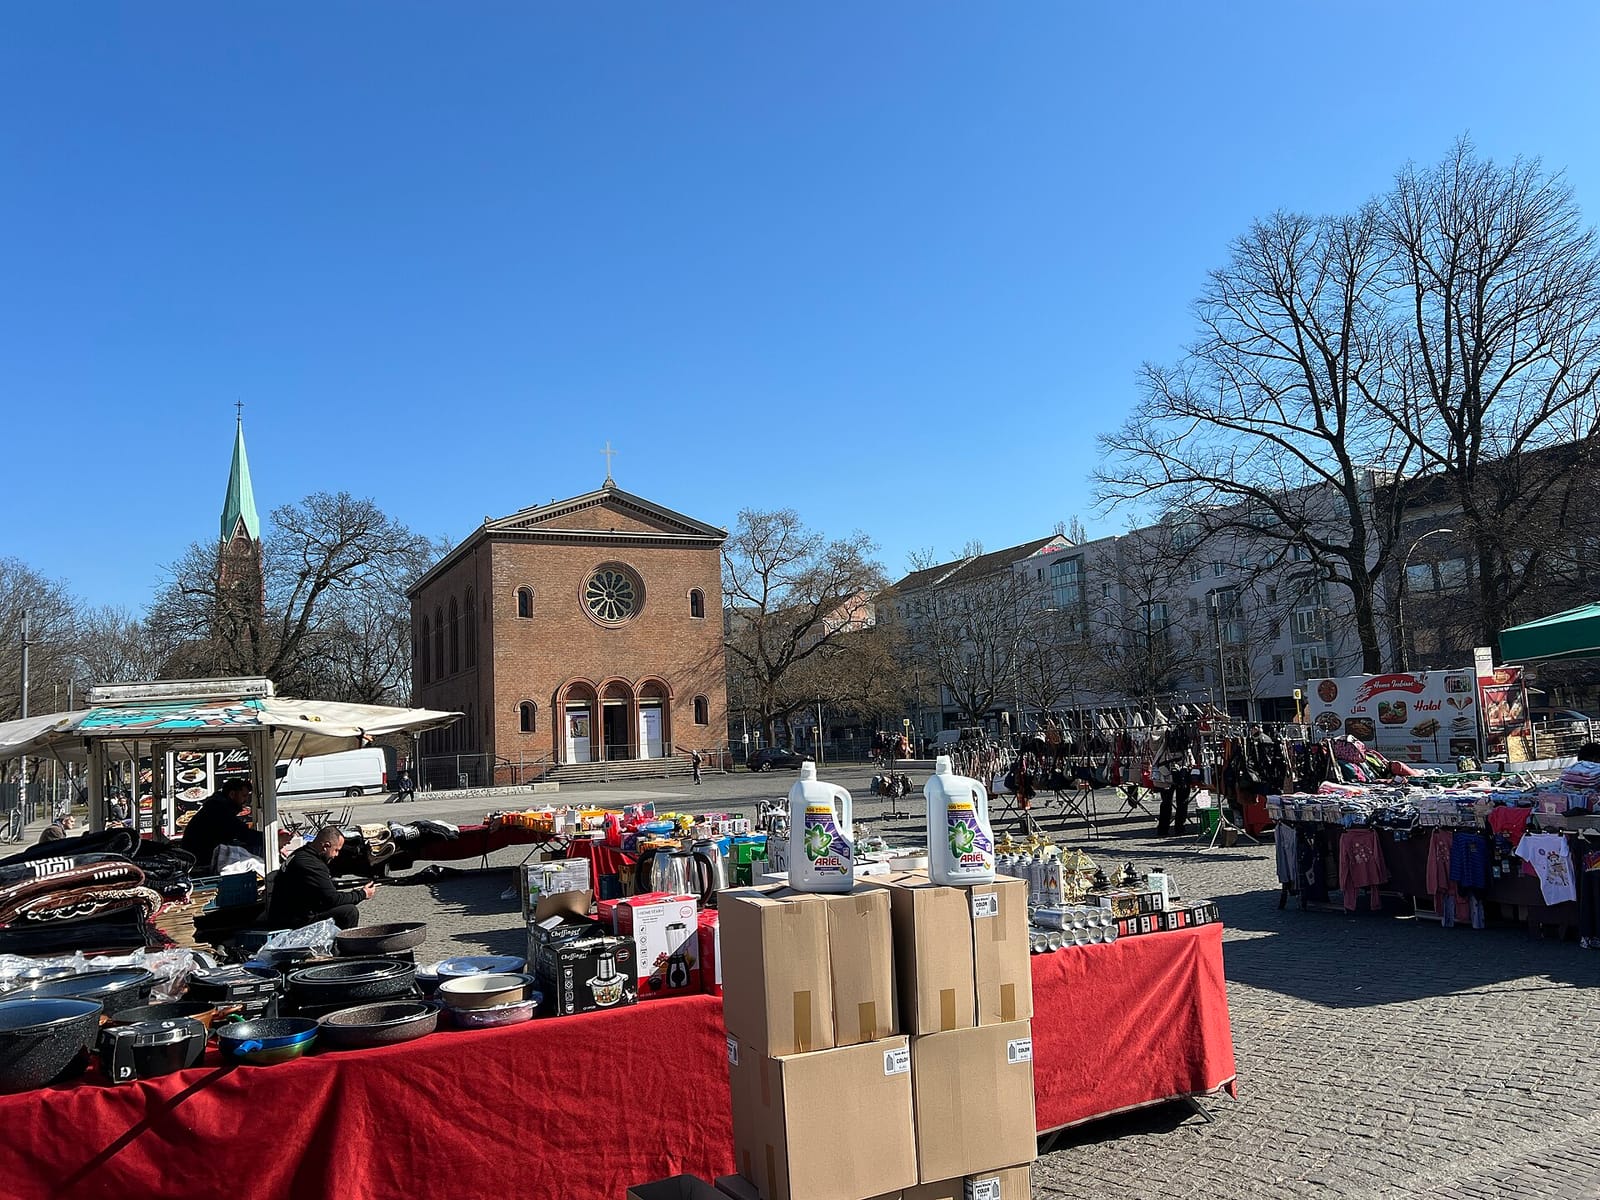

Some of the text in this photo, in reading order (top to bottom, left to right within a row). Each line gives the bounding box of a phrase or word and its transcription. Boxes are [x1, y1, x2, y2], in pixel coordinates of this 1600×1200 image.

[1413, 700, 1442, 712] Halal
[814, 857, 842, 866] ARIEL
[960, 853, 986, 863] ARIEL
